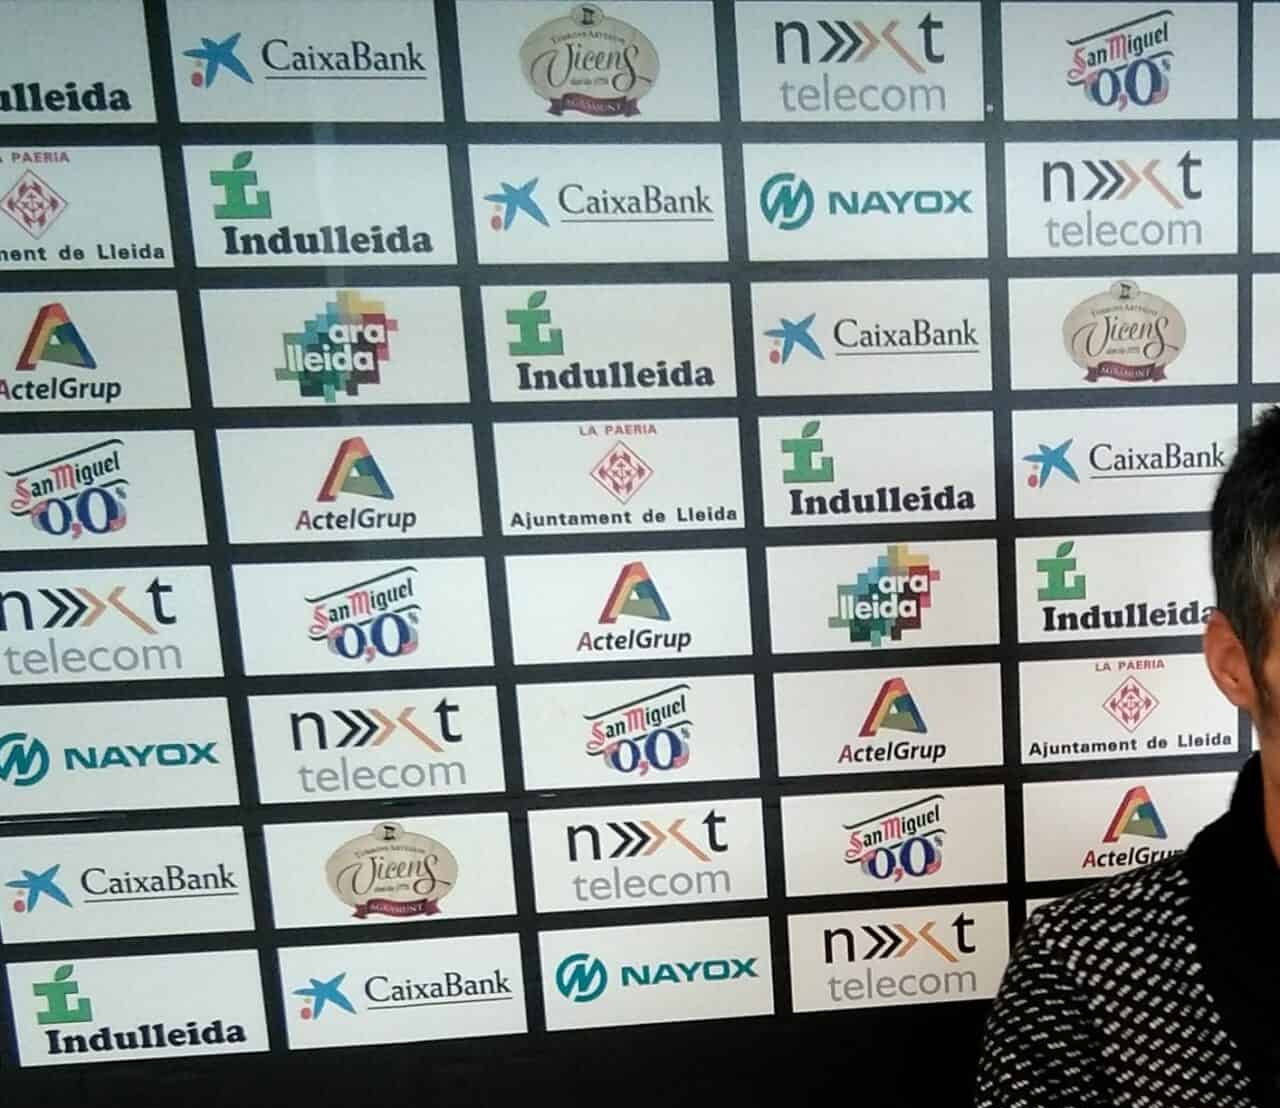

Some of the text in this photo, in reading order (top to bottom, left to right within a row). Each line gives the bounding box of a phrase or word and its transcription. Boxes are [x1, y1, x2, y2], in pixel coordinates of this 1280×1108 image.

[261, 38, 425, 72] CaixaBank
[779, 77, 946, 112] telecom
[11, 151, 71, 163] PAERIA
[558, 184, 713, 216] CaixaBank
[829, 189, 973, 214] NAYOX
[223, 225, 433, 256] Indulleida
[1046, 213, 1201, 247] telecom
[58, 245, 85, 261] de
[97, 243, 165, 260] Lleida
[328, 322, 386, 345] ara
[833, 317, 978, 348] CaixaBank
[287, 343, 375, 372] lleida
[0, 377, 121, 403] ActelGrup
[517, 361, 714, 391] Indulleida
[578, 424, 656, 436] LA PAERIA
[1089, 441, 1225, 472] CaixaBank
[789, 486, 976, 516] Indulleida
[295, 508, 417, 532] ActelGrup
[510, 507, 737, 529] Ajuntament de Lleida
[877, 572, 929, 594] ara
[840, 594, 918, 619] lleida
[576, 628, 691, 652] ActelGrup
[5, 637, 182, 675] telecom
[1095, 659, 1164, 672] LA PAERIA
[65, 741, 219, 769] NAYOX
[838, 741, 946, 762] ActelGrup
[1029, 732, 1232, 756] Ajuntament de Lleida
[298, 756, 466, 792] telecom
[81, 865, 237, 896] CaixaBank
[573, 866, 730, 901] telecom
[621, 957, 757, 986] NAYOX
[829, 967, 976, 1002] telecom
[365, 971, 511, 1002] CaixaBank
[46, 1021, 247, 1054] Indulleida
